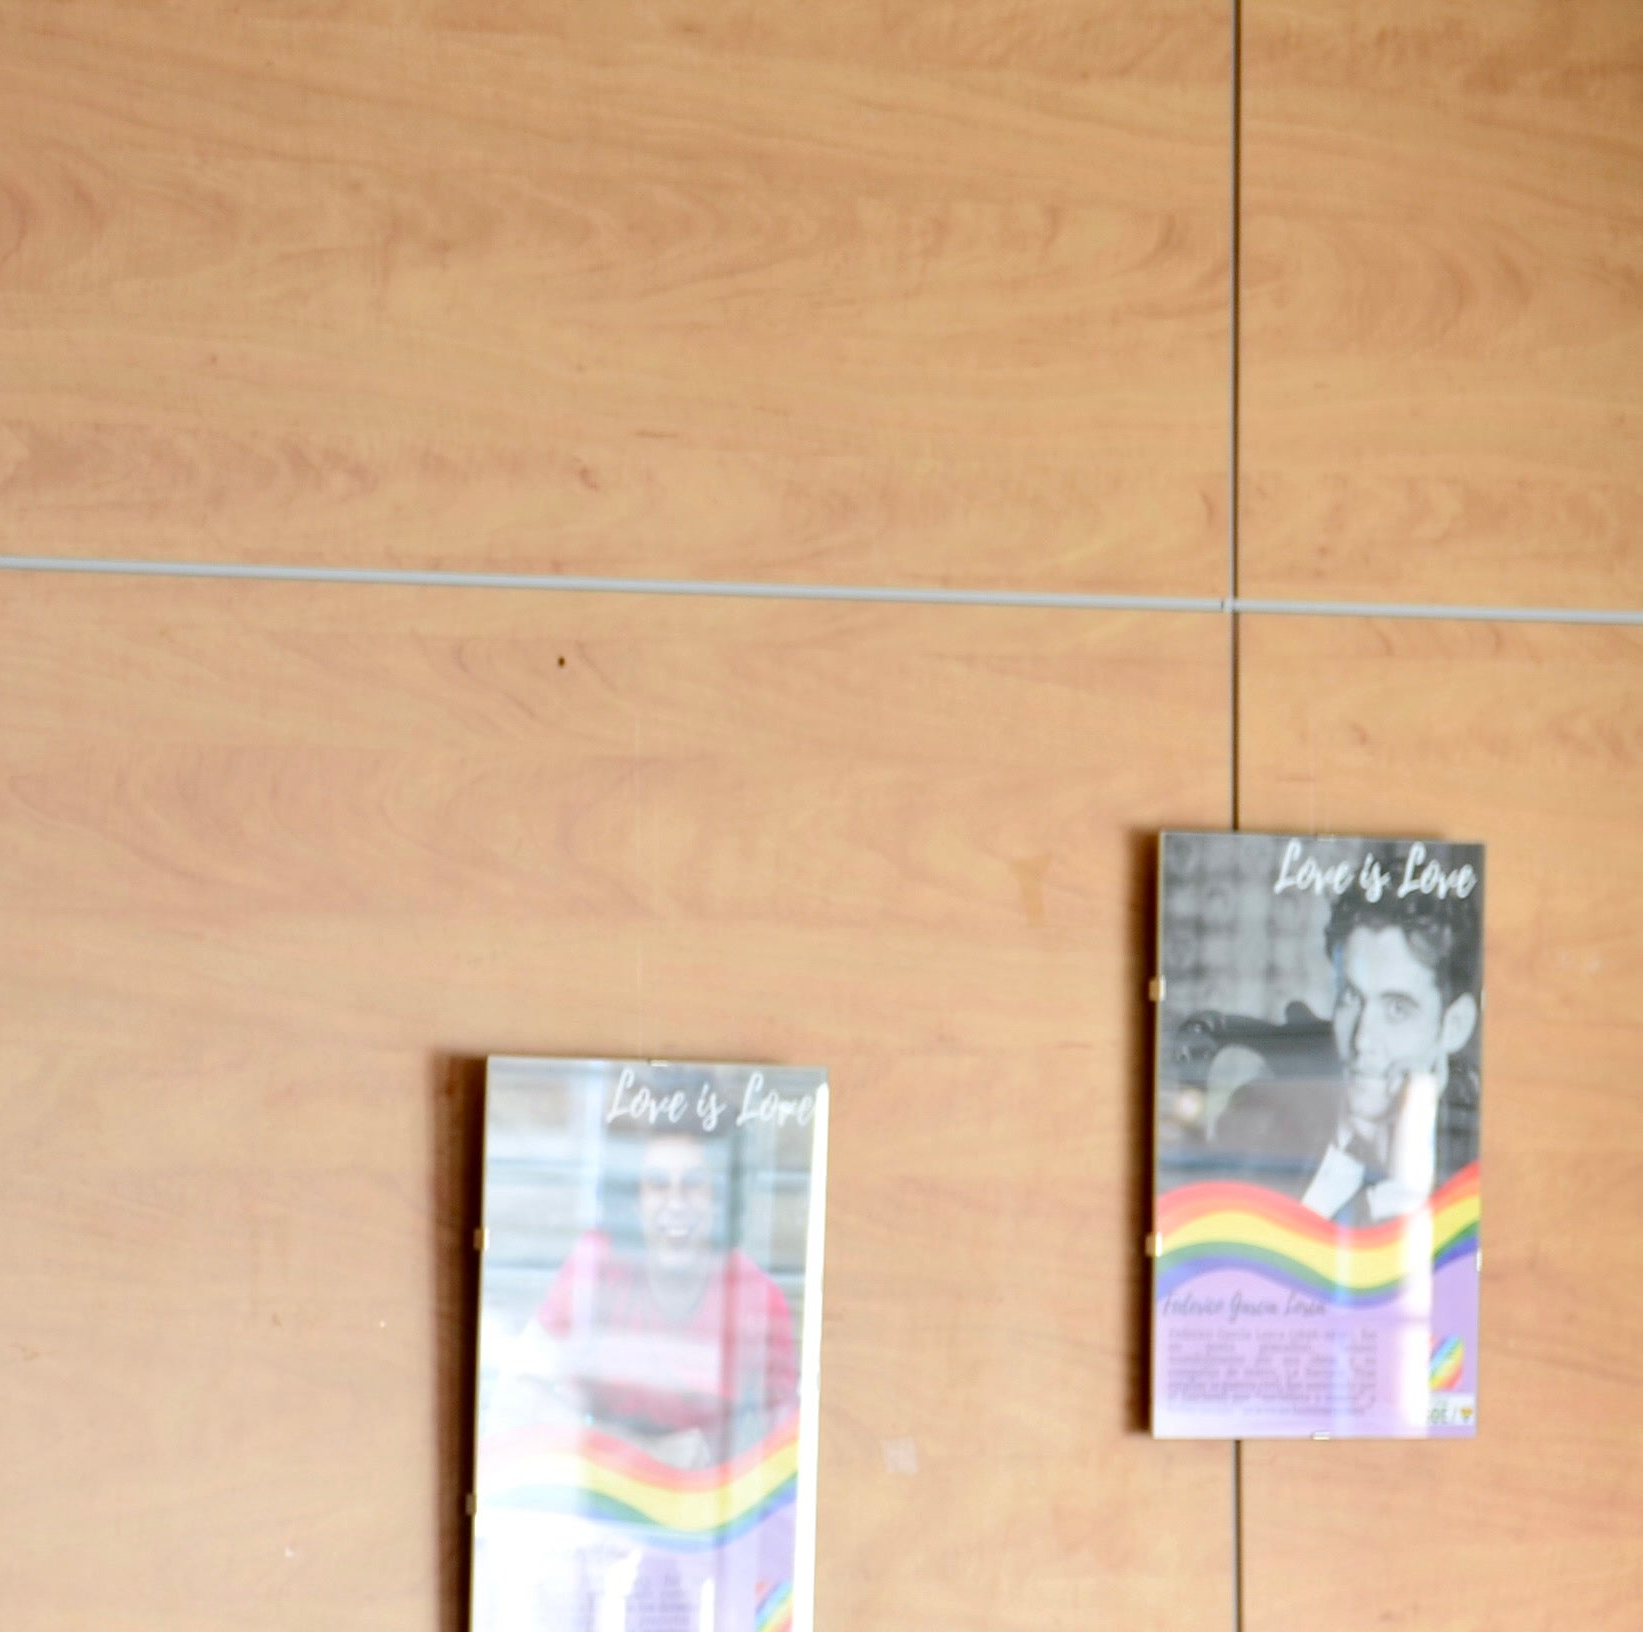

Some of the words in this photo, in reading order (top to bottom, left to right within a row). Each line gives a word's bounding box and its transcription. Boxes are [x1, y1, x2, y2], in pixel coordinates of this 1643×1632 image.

[1274, 837, 1354, 895] Love
[1359, 852, 1390, 903] is
[1396, 841, 1477, 899] Love
[606, 1067, 688, 1124] Love
[696, 1083, 726, 1132] is
[736, 1071, 814, 1127] Love
